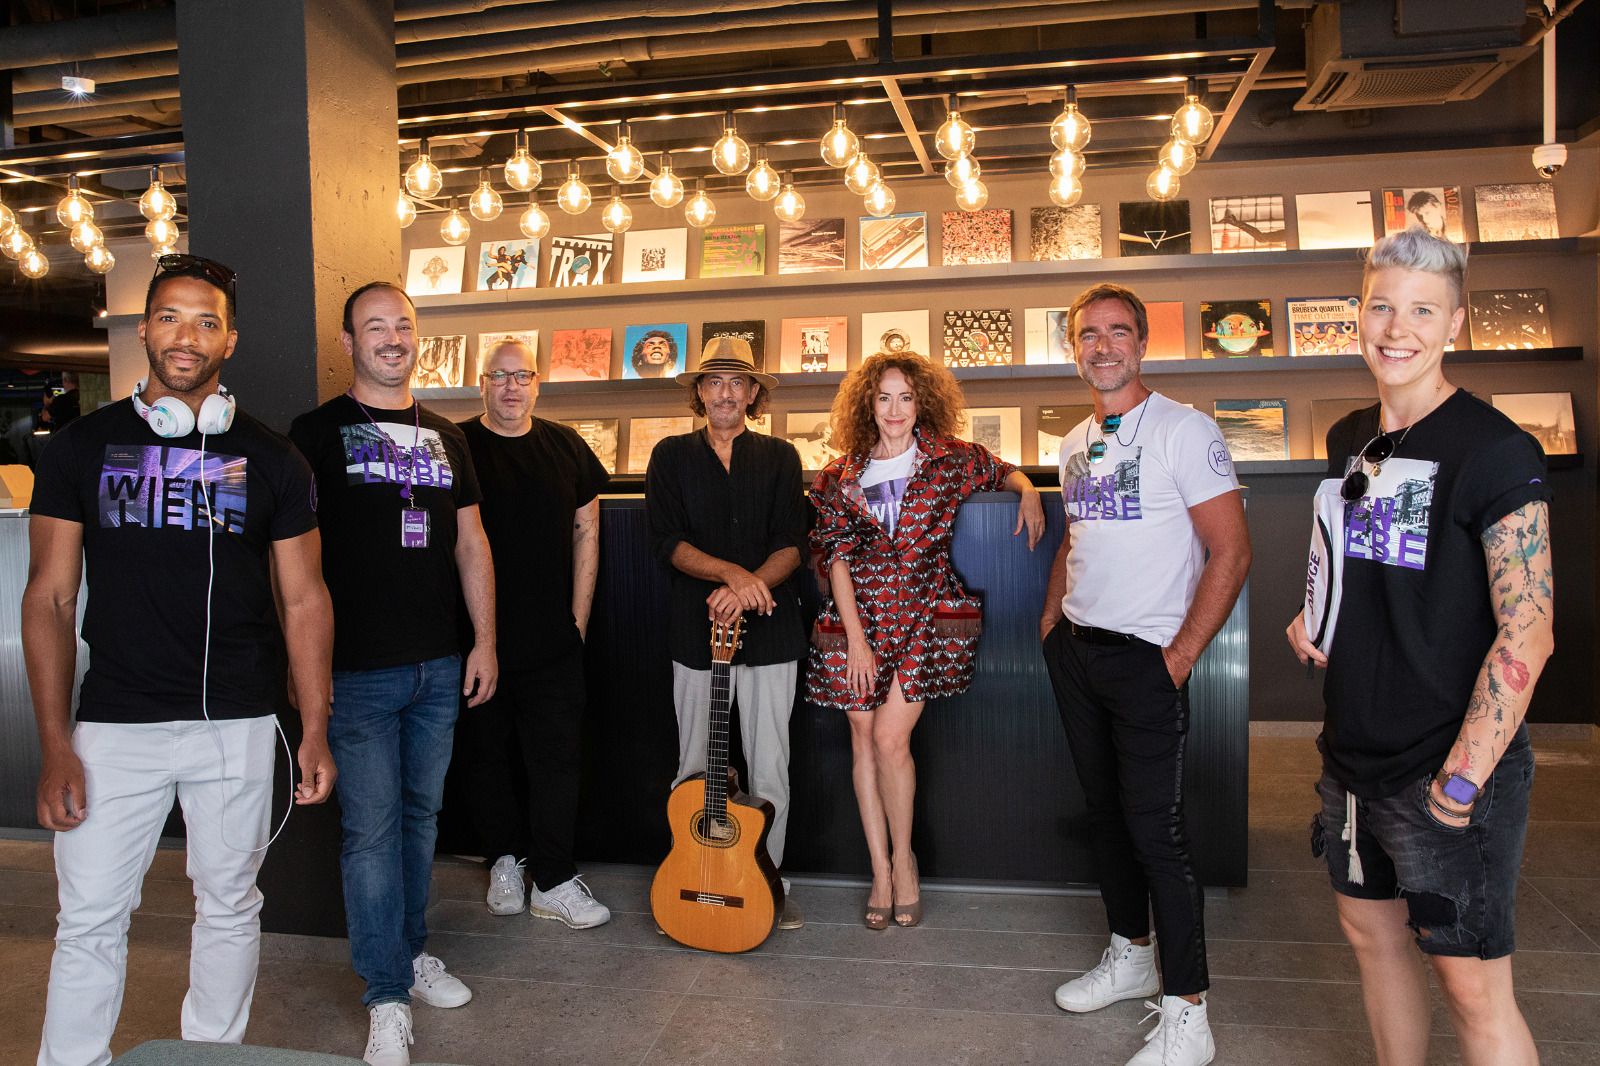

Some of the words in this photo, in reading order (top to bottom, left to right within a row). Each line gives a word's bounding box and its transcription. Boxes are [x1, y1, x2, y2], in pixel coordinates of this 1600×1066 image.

[1291, 306, 1318, 314] BRUBECK
[1319, 305, 1345, 313] QUARTET
[1292, 313, 1313, 321] TIME
[1314, 312, 1331, 320] OUT
[352, 442, 432, 466] WIEN
[364, 461, 452, 489] LIEBE
[107, 475, 217, 507] WIEN
[118, 498, 246, 535] LIEBE
